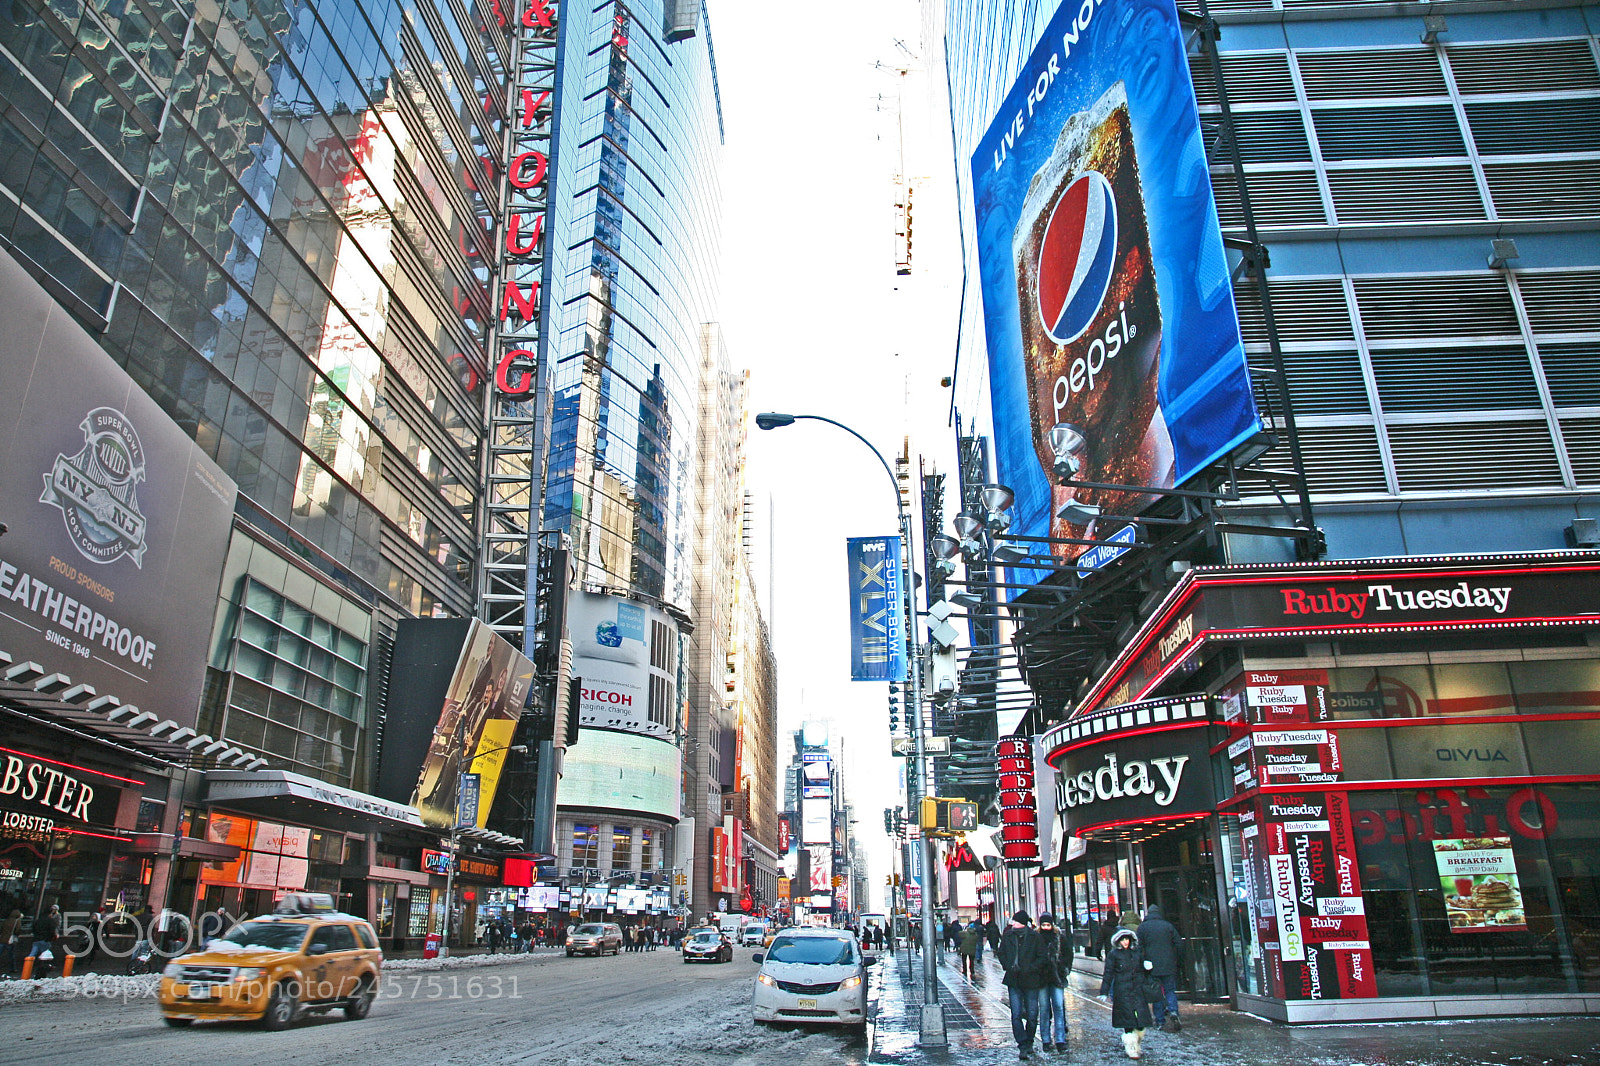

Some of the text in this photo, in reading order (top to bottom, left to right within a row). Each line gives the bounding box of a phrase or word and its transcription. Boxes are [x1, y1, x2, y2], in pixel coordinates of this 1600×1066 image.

[994, 0, 1103, 172] LIVE FOR NO
[496, 90, 549, 394] YOUNG
[97, 416, 140, 458] SUPER BOWL
[100, 442, 127, 475] XLVIII
[59, 468, 139, 534] NY NJ
[67, 507, 124, 557] HOST COMMITTEE
[863, 543, 885, 552] NYC
[49, 556, 115, 602] PROUD SPONSORS
[859, 560, 887, 663] XLVIII
[885, 559, 900, 662] SUPER BOWL
[1280, 582, 1512, 619] Ruby Tuesday
[45, 629, 91, 659] SINCE 1948
[1159, 613, 1193, 662] Tuesday
[1251, 673, 1278, 684] Ruby
[1259, 687, 1284, 696] Ruby
[580, 688, 632, 706] RICOH
[608, 705, 632, 716] change.
[1258, 694, 1298, 704] Tuesday
[1272, 705, 1294, 714] Ruby
[1317, 686, 1327, 719] Tuesday
[900, 743, 916, 751] ONE
[1265, 753, 1308, 763] Tuesday
[1329, 733, 1340, 770] Tuesday
[1014, 741, 1026, 803] Ruby
[1055, 753, 1189, 813] uesday
[1298, 773, 1338, 783] Tuesday
[463, 788, 473, 820] BLVD
[1270, 804, 1322, 817] Tuesday
[1272, 795, 1305, 806] Ruby
[3, 812, 54, 834] LOBSTER
[1276, 824, 1285, 853] Tuesday
[1295, 835, 1315, 907] Tuesday
[1309, 840, 1325, 884] Ruby
[1339, 854, 1353, 895] Ruby
[1447, 857, 1503, 865] BREAKFAST
[1323, 904, 1356, 914] Tuesday
[1324, 898, 1345, 906] Ruby
[1310, 917, 1342, 929] Ruby
[1301, 964, 1311, 997] Ruby
[1307, 946, 1321, 999] Tuesday
[1351, 953, 1362, 981] Ruby
